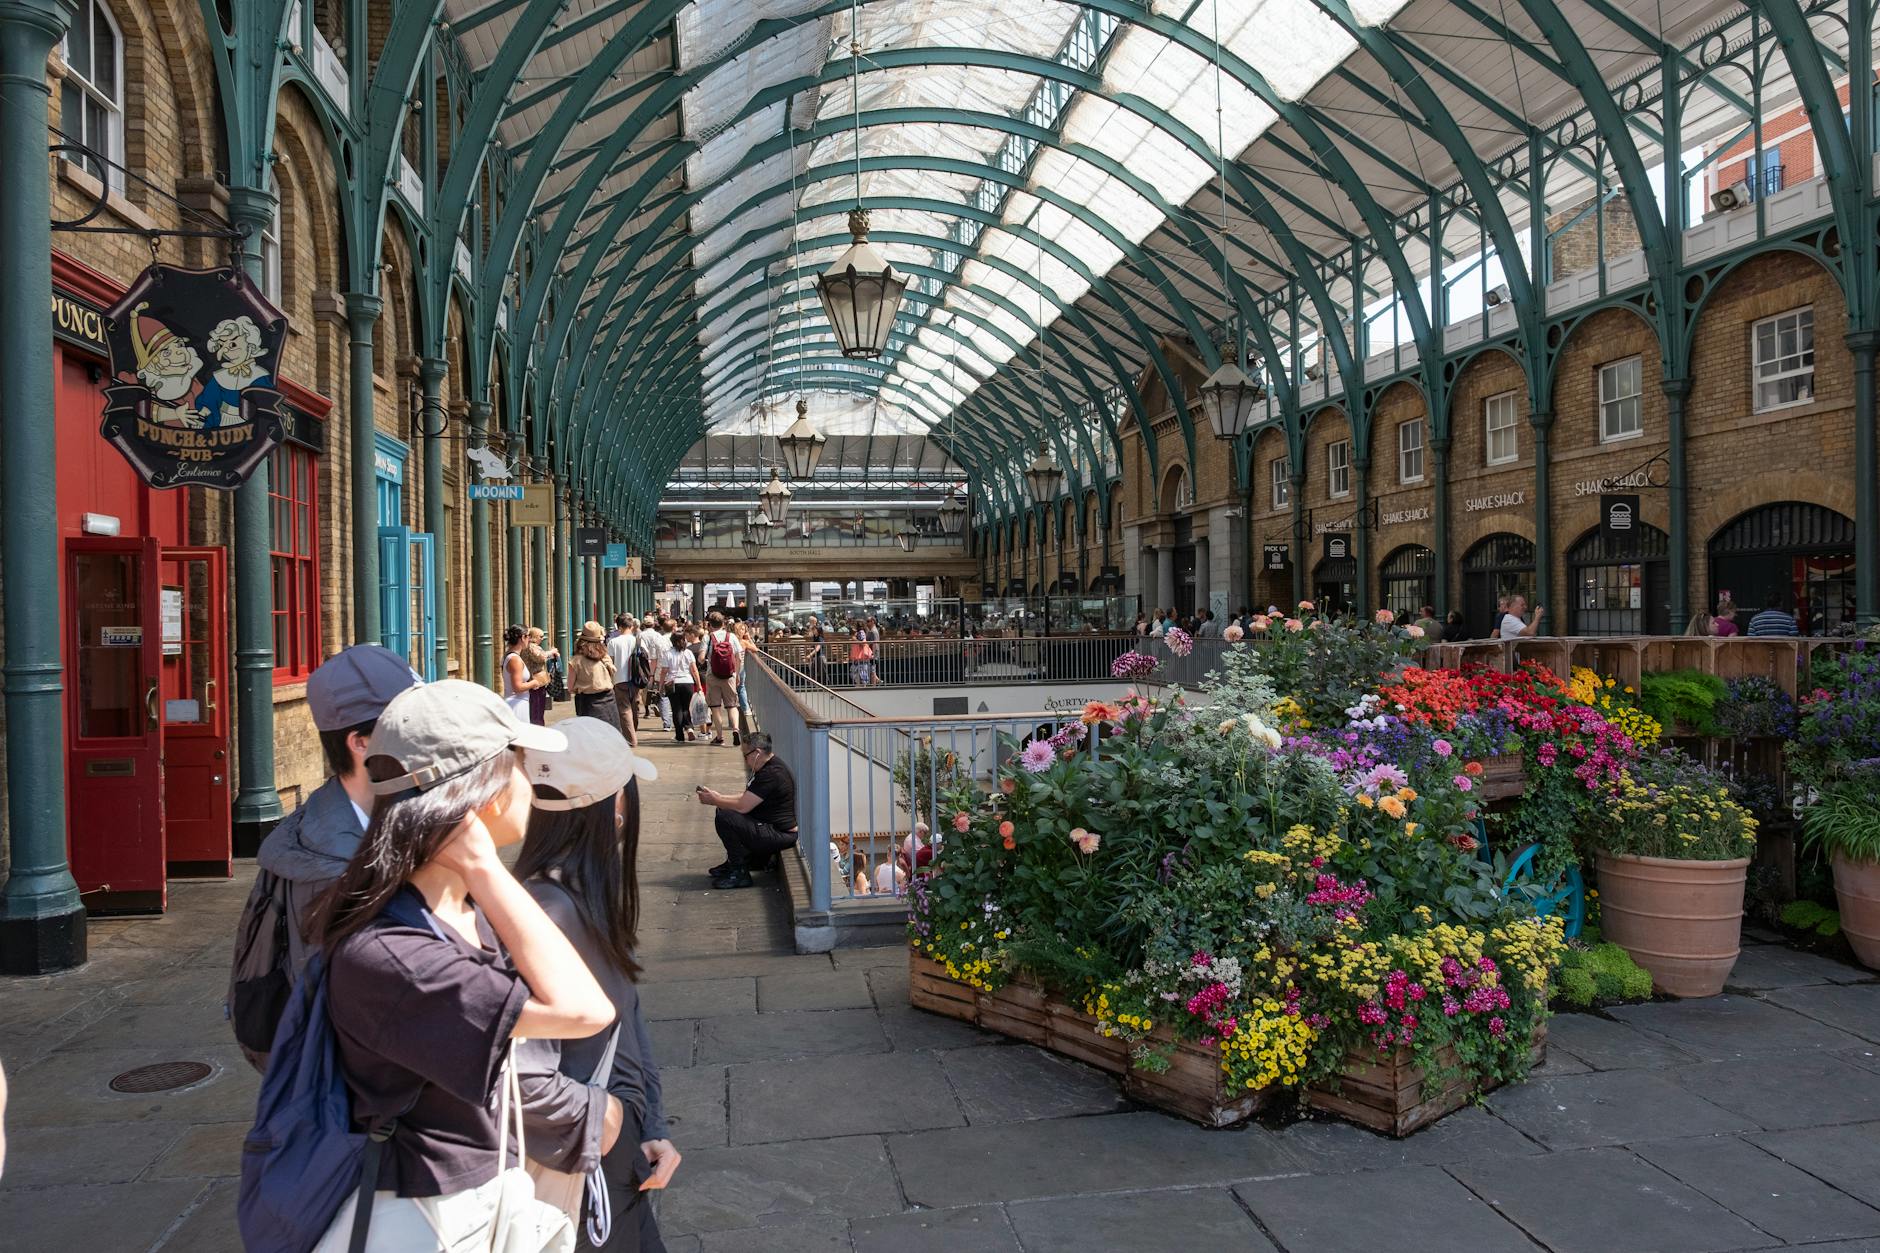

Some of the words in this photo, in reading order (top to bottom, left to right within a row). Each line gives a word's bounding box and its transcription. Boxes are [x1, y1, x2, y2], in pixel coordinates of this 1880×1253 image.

[137, 418, 195, 447] PUNCH
[196, 434, 206, 447] &
[208, 424, 254, 447] JUDY
[180, 449, 213, 461] PUB
[177, 462, 222, 478] Entrance
[474, 486, 518, 499] MOOMIN
[1466, 496, 1494, 512] SHAKE
[1494, 491, 1524, 508] SHACK
[1382, 511, 1405, 525] SHAKE
[1405, 507, 1429, 522] SHACK
